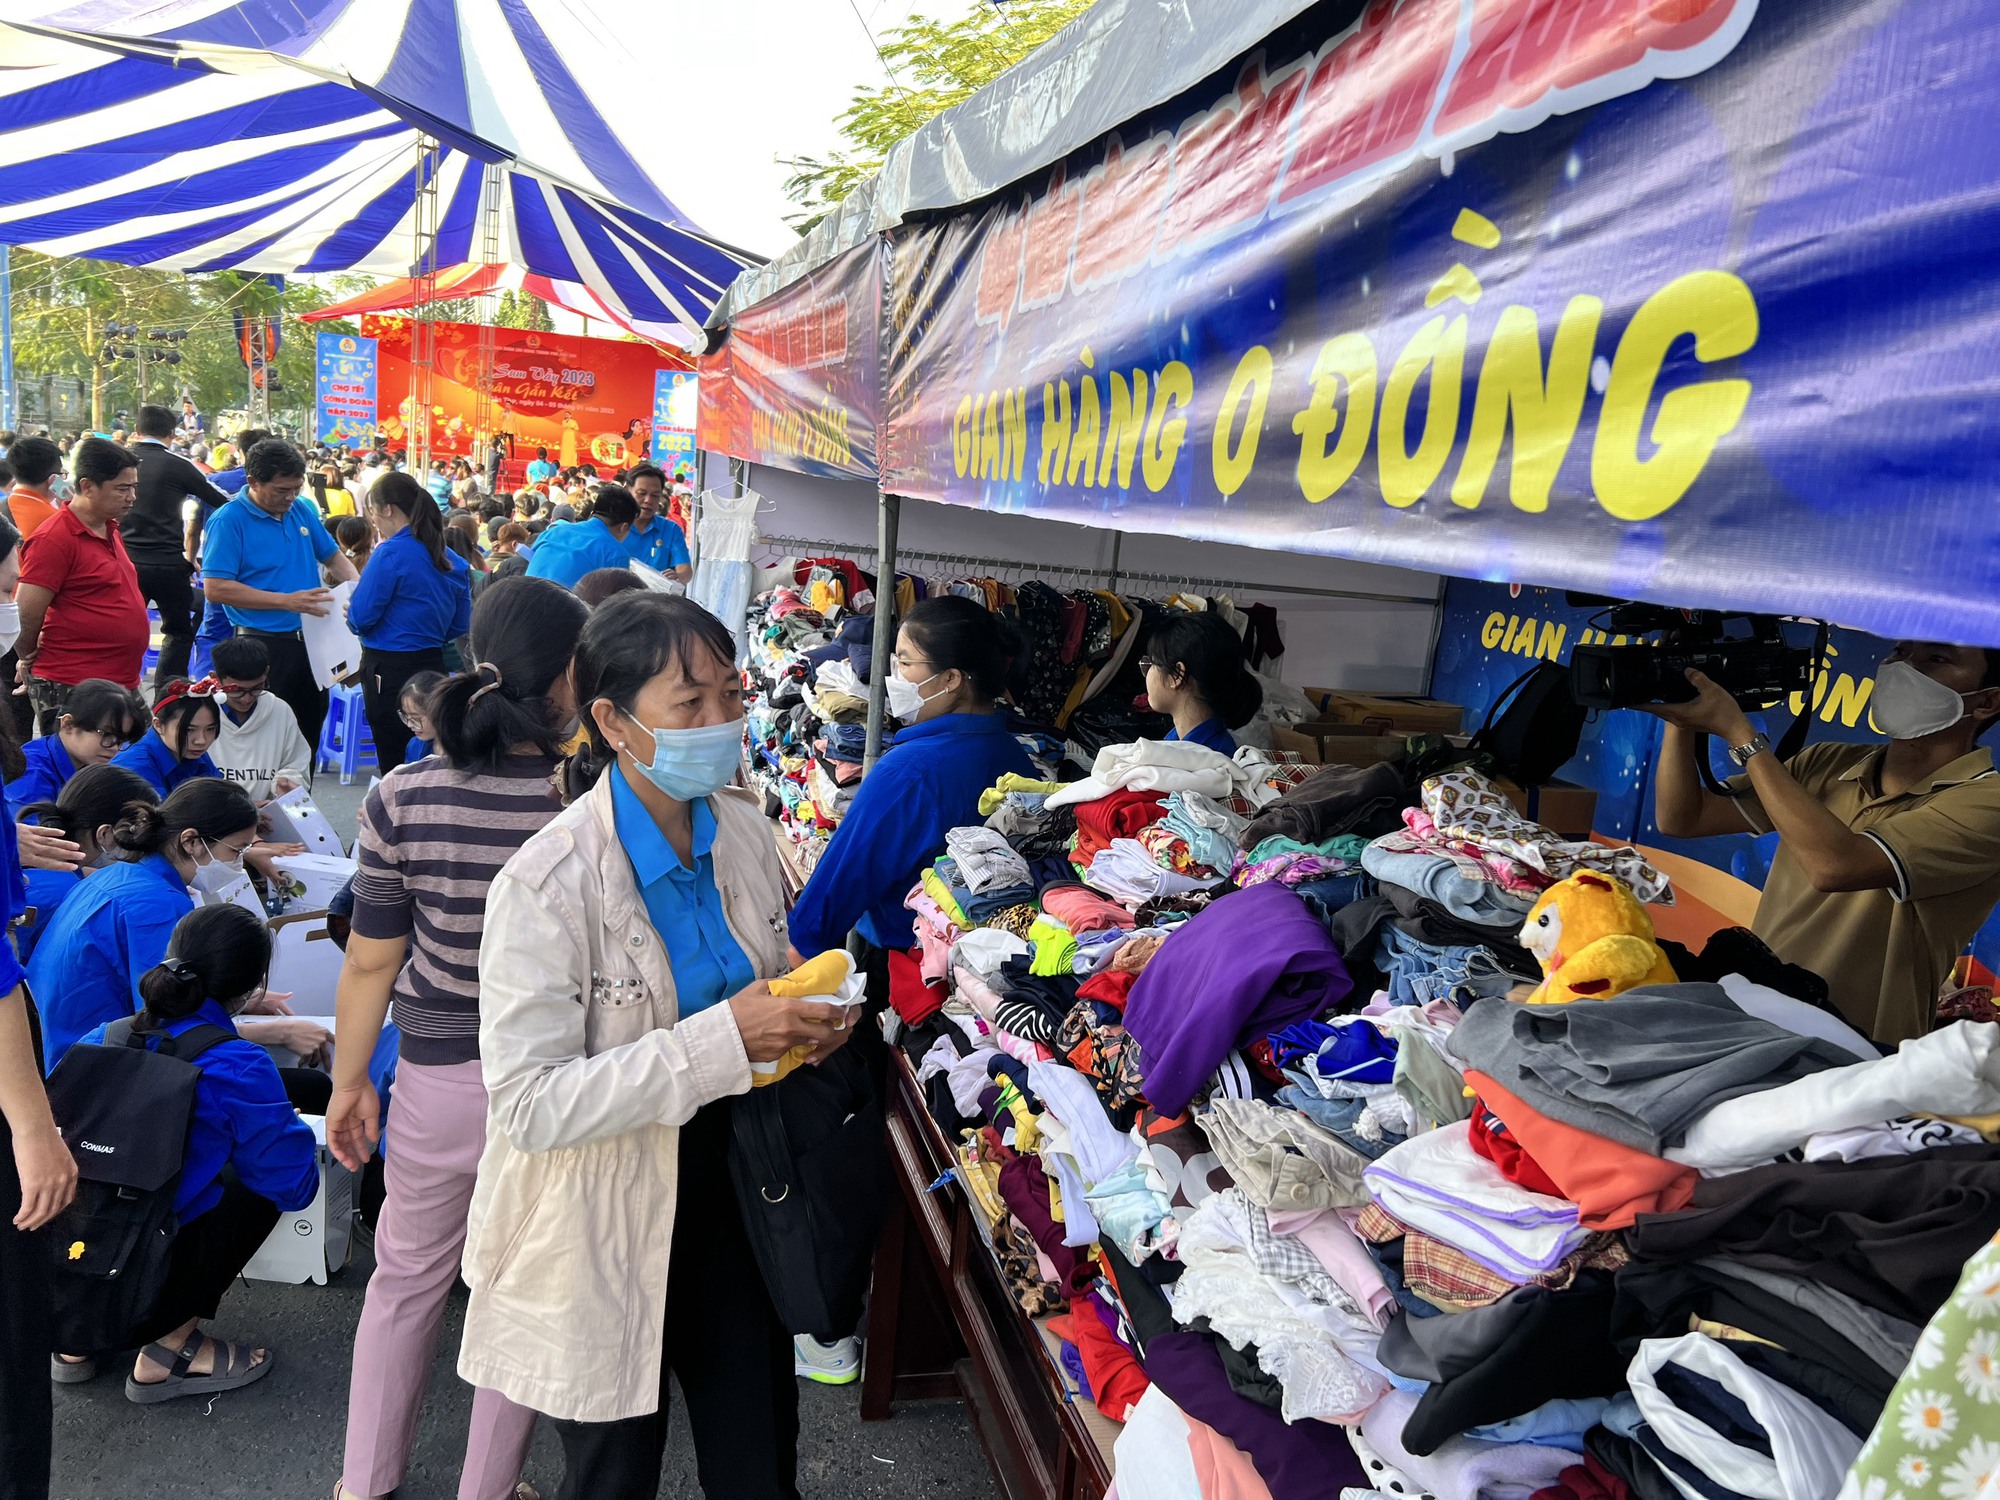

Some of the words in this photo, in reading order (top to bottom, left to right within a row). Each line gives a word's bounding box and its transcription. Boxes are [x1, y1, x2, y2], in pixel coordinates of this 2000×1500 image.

[492, 363, 527, 379] Sum
[561, 370, 595, 386] 2023
[952, 385, 1028, 483] GIAN
[1038, 344, 1195, 493] HÀNG
[1292, 207, 1759, 521] ĐỒNG
[331, 384, 350, 393] CHỢ
[351, 384, 365, 393] TẾT
[515, 382, 547, 399] Gắn
[550, 384, 578, 401] Kết
[323, 395, 348, 404] CÔNG
[349, 397, 374, 406] ĐOÀN
[1481, 611, 1567, 663] GIAN
